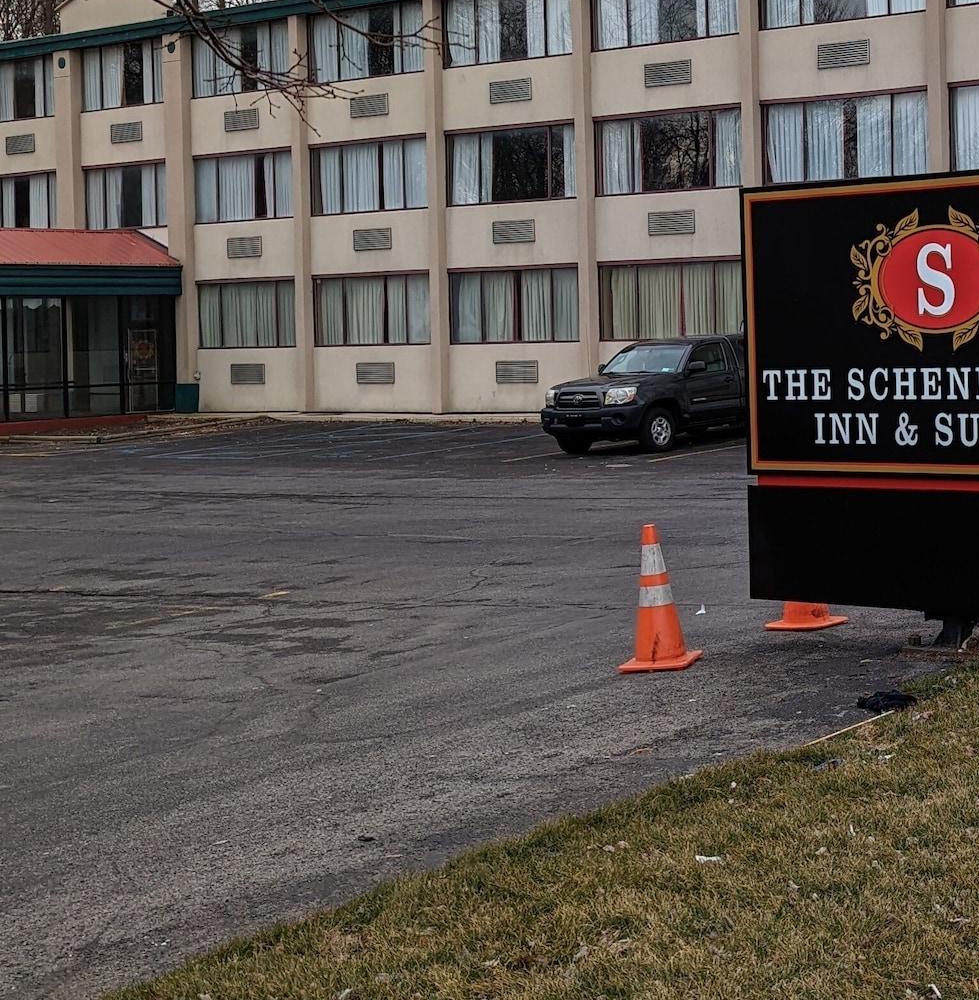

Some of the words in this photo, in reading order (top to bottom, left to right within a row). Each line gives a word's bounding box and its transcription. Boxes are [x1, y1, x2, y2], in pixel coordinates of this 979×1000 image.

[916, 242, 956, 316] S
[763, 369, 831, 401] THE
[814, 413, 879, 445] INN
[895, 412, 919, 446] &
